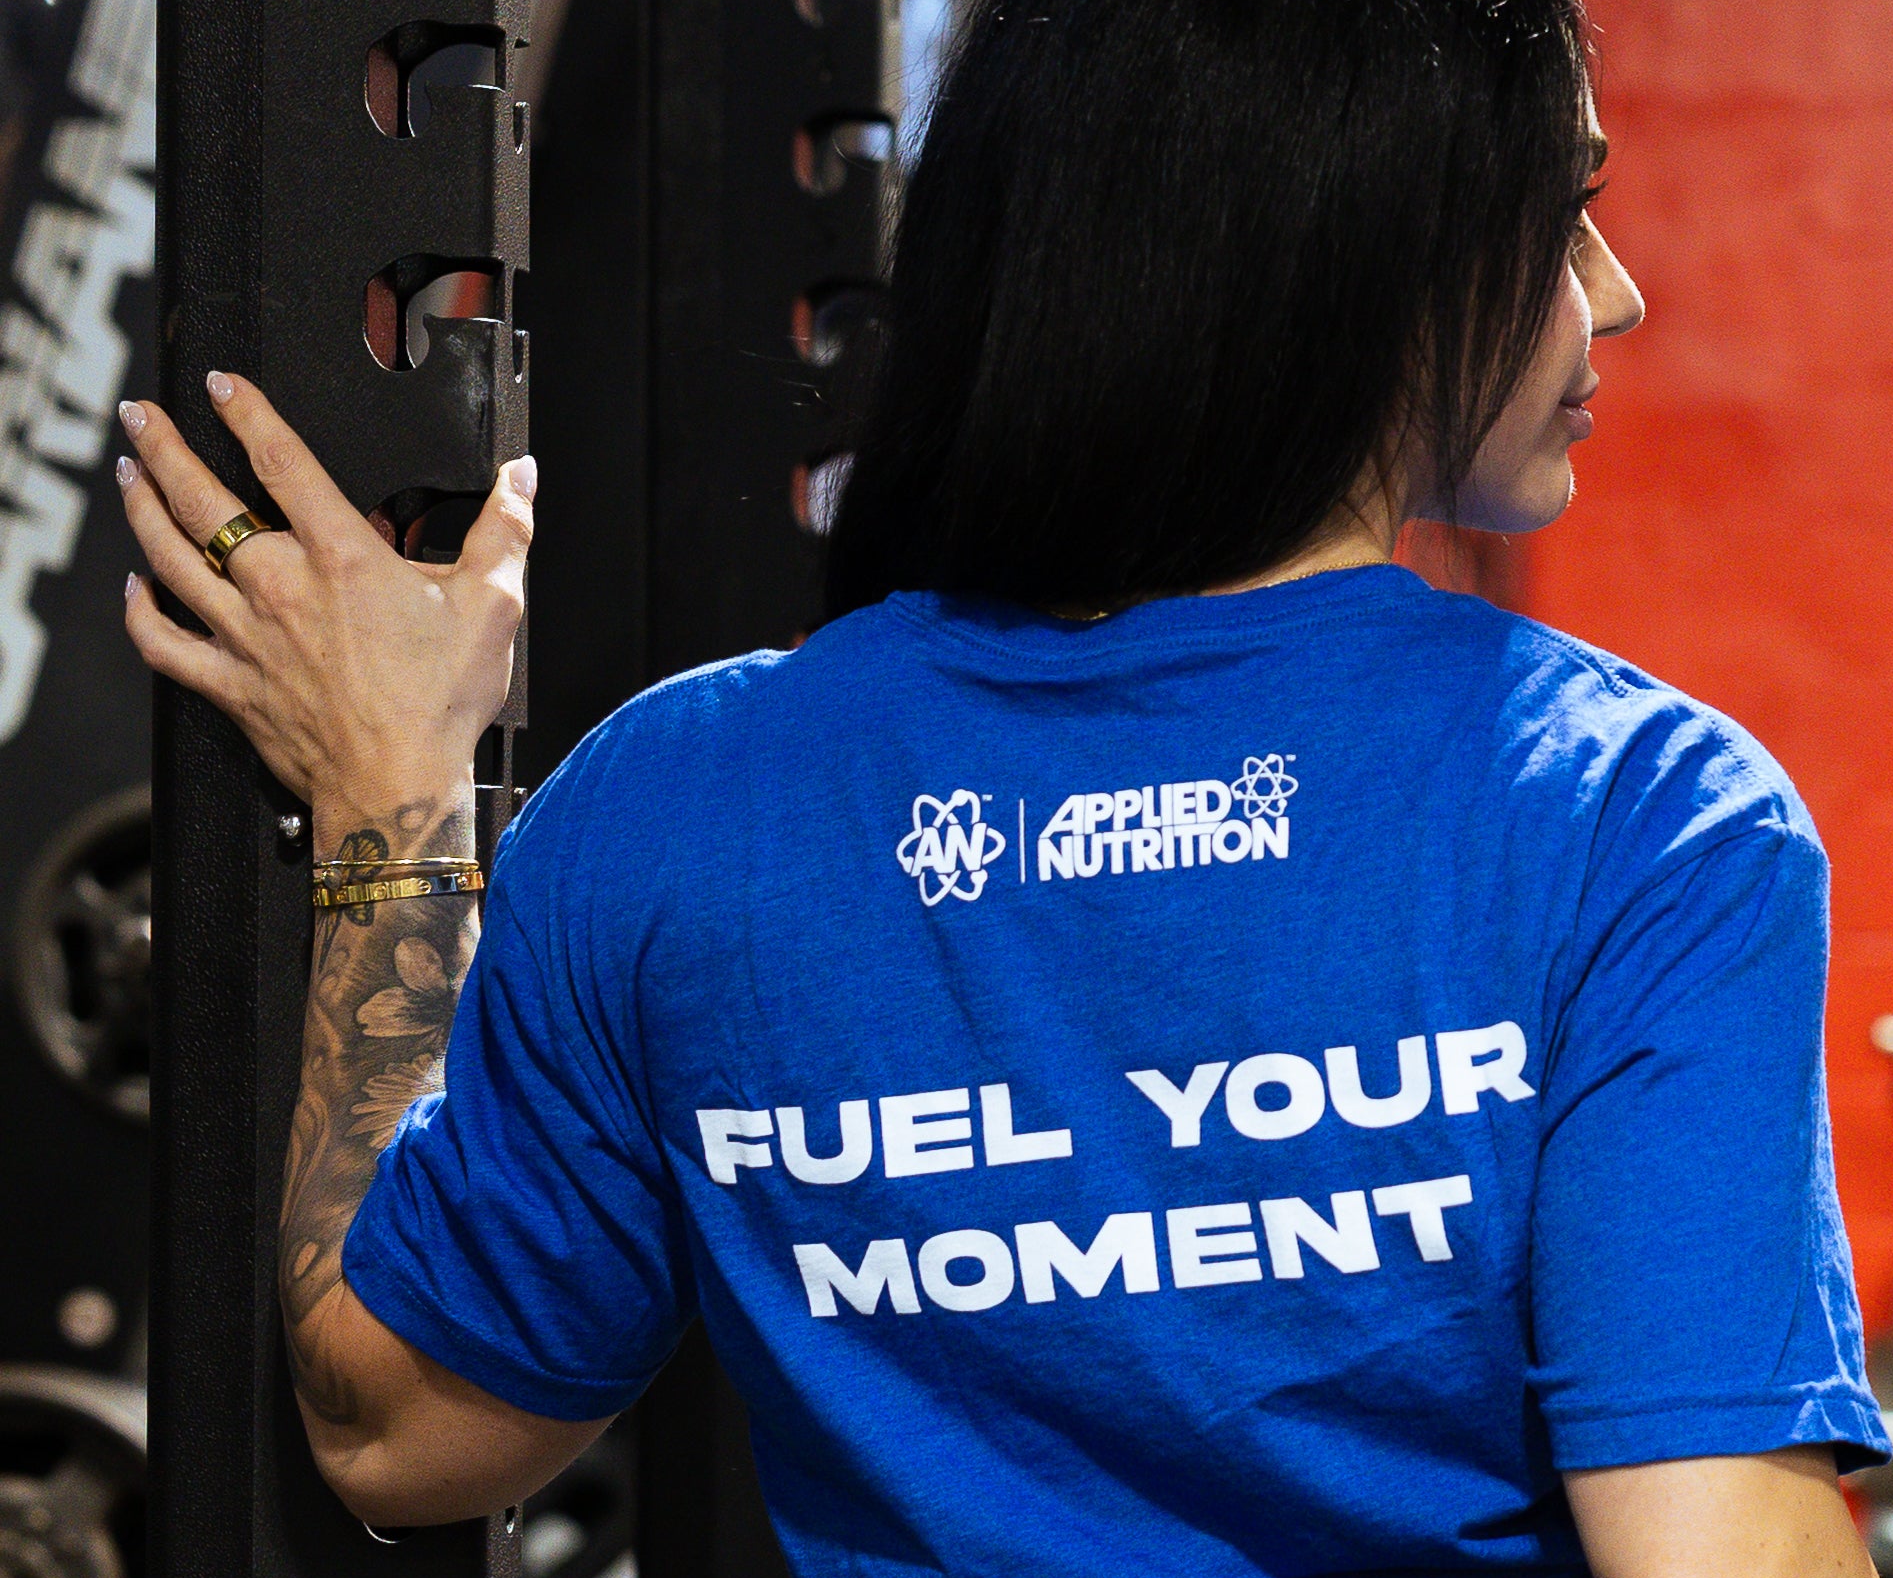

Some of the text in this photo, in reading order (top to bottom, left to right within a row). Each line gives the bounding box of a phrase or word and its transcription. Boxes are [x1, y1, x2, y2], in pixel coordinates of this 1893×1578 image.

[1038, 778, 1233, 840] APPLIED
[910, 821, 988, 877] AN
[1036, 815, 1291, 882] NUTRITION
[695, 1019, 1537, 1186] FUEL YOUR
[792, 1173, 1473, 1319] MOMENT
